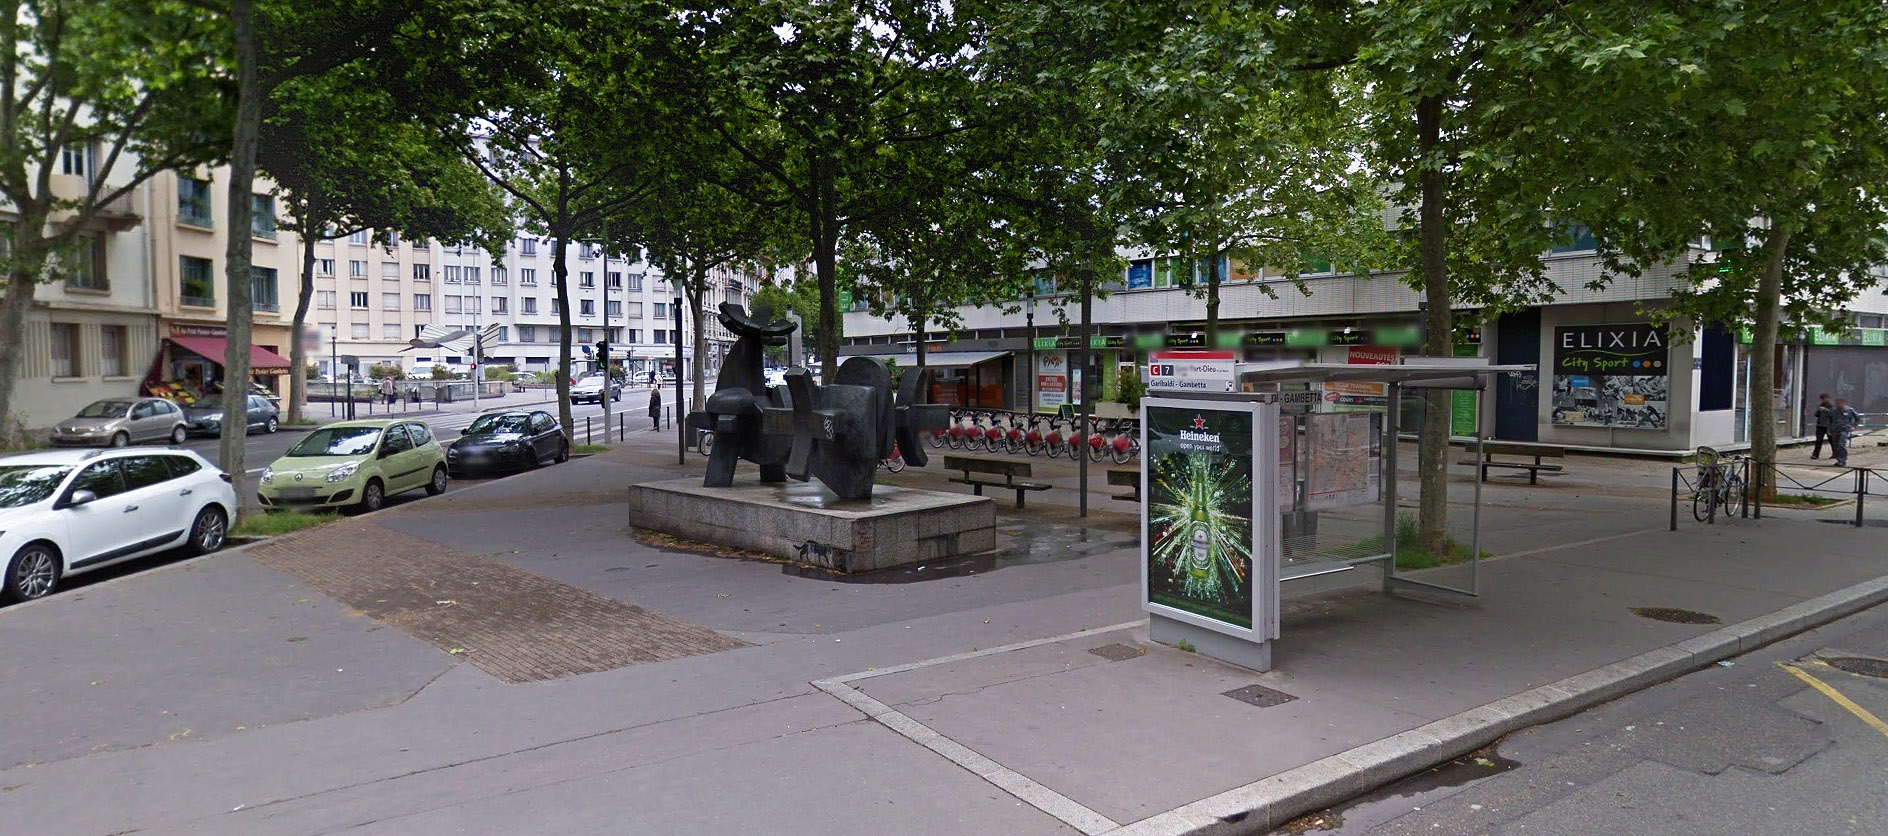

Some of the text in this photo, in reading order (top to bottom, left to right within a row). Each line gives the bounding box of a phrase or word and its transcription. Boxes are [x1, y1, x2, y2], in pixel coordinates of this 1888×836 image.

[1258, 336, 1271, 345] Sport
[1343, 334, 1358, 343] Sport
[1563, 331, 1661, 348] ELIXIA
[1033, 340, 1056, 348] ELIXIA
[1562, 357, 1628, 372] City Sport
[1152, 366, 1158, 375] C
[1165, 366, 1170, 375] 7
[1179, 381, 1207, 389] Gambetta
[1284, 392, 1322, 403] GAMBETTA
[1180, 430, 1220, 442] Heineken
